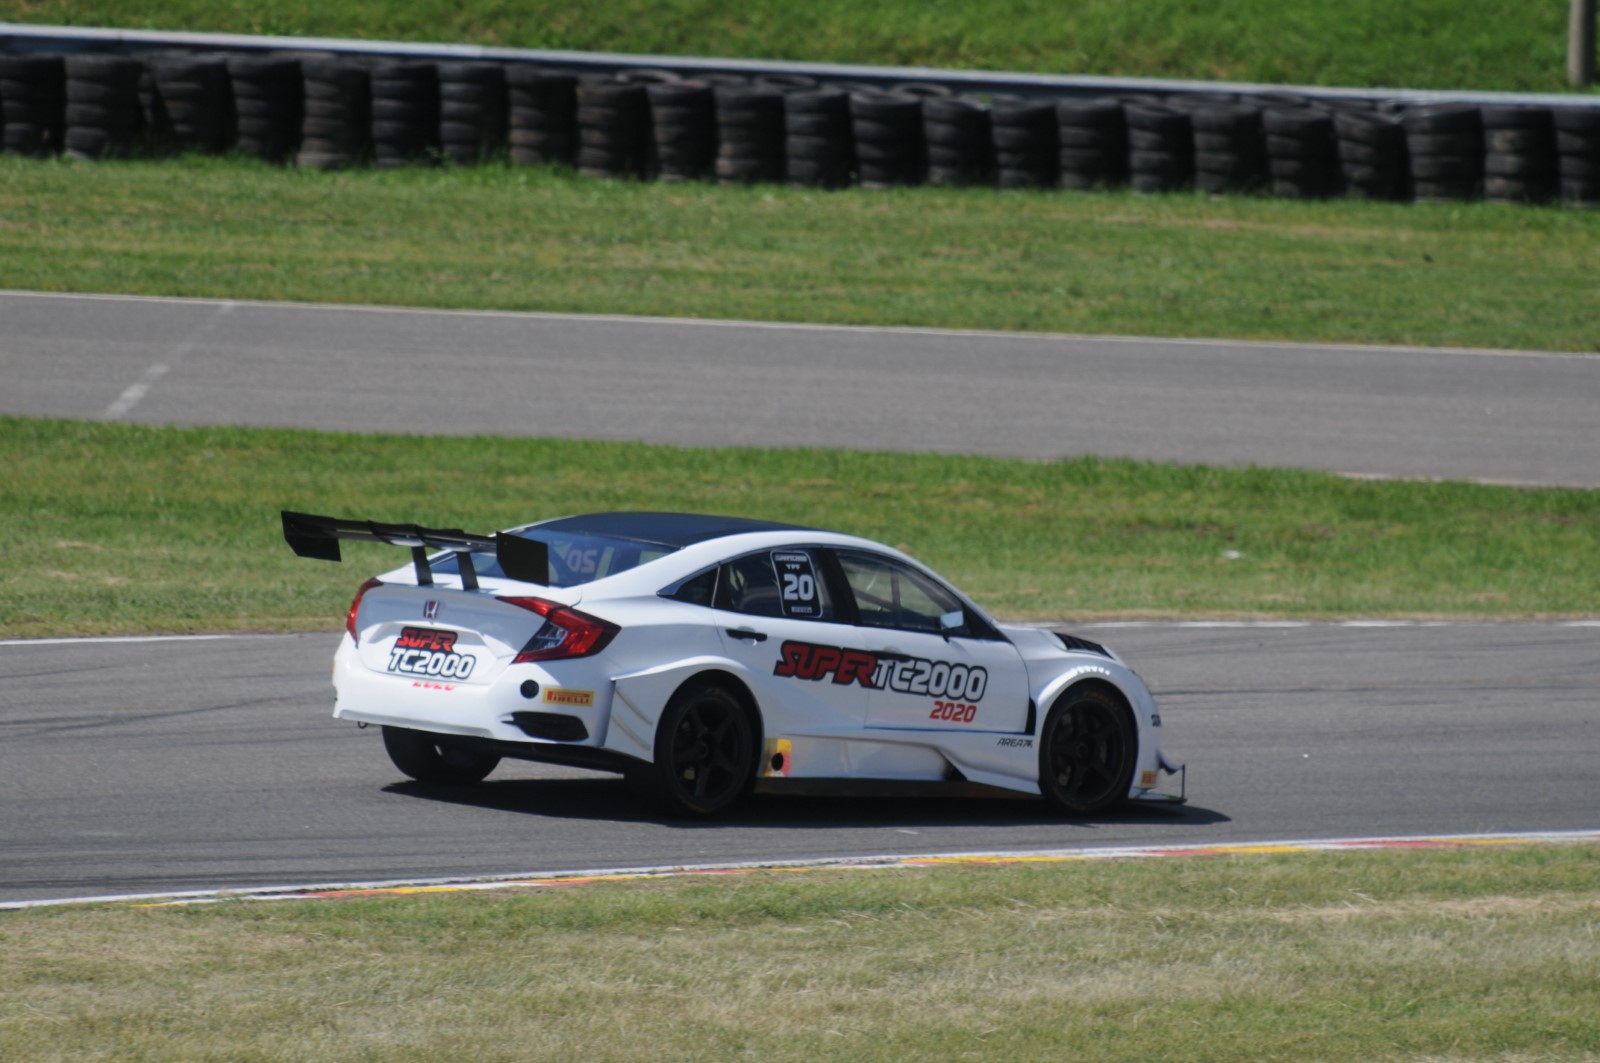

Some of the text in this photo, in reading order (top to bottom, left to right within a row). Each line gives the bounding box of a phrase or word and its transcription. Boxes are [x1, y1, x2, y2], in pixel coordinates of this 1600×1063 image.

[783, 573, 814, 601] 20
[395, 626, 458, 651] SUPER
[387, 648, 477, 680] TC2000
[929, 700, 977, 723] 2020
